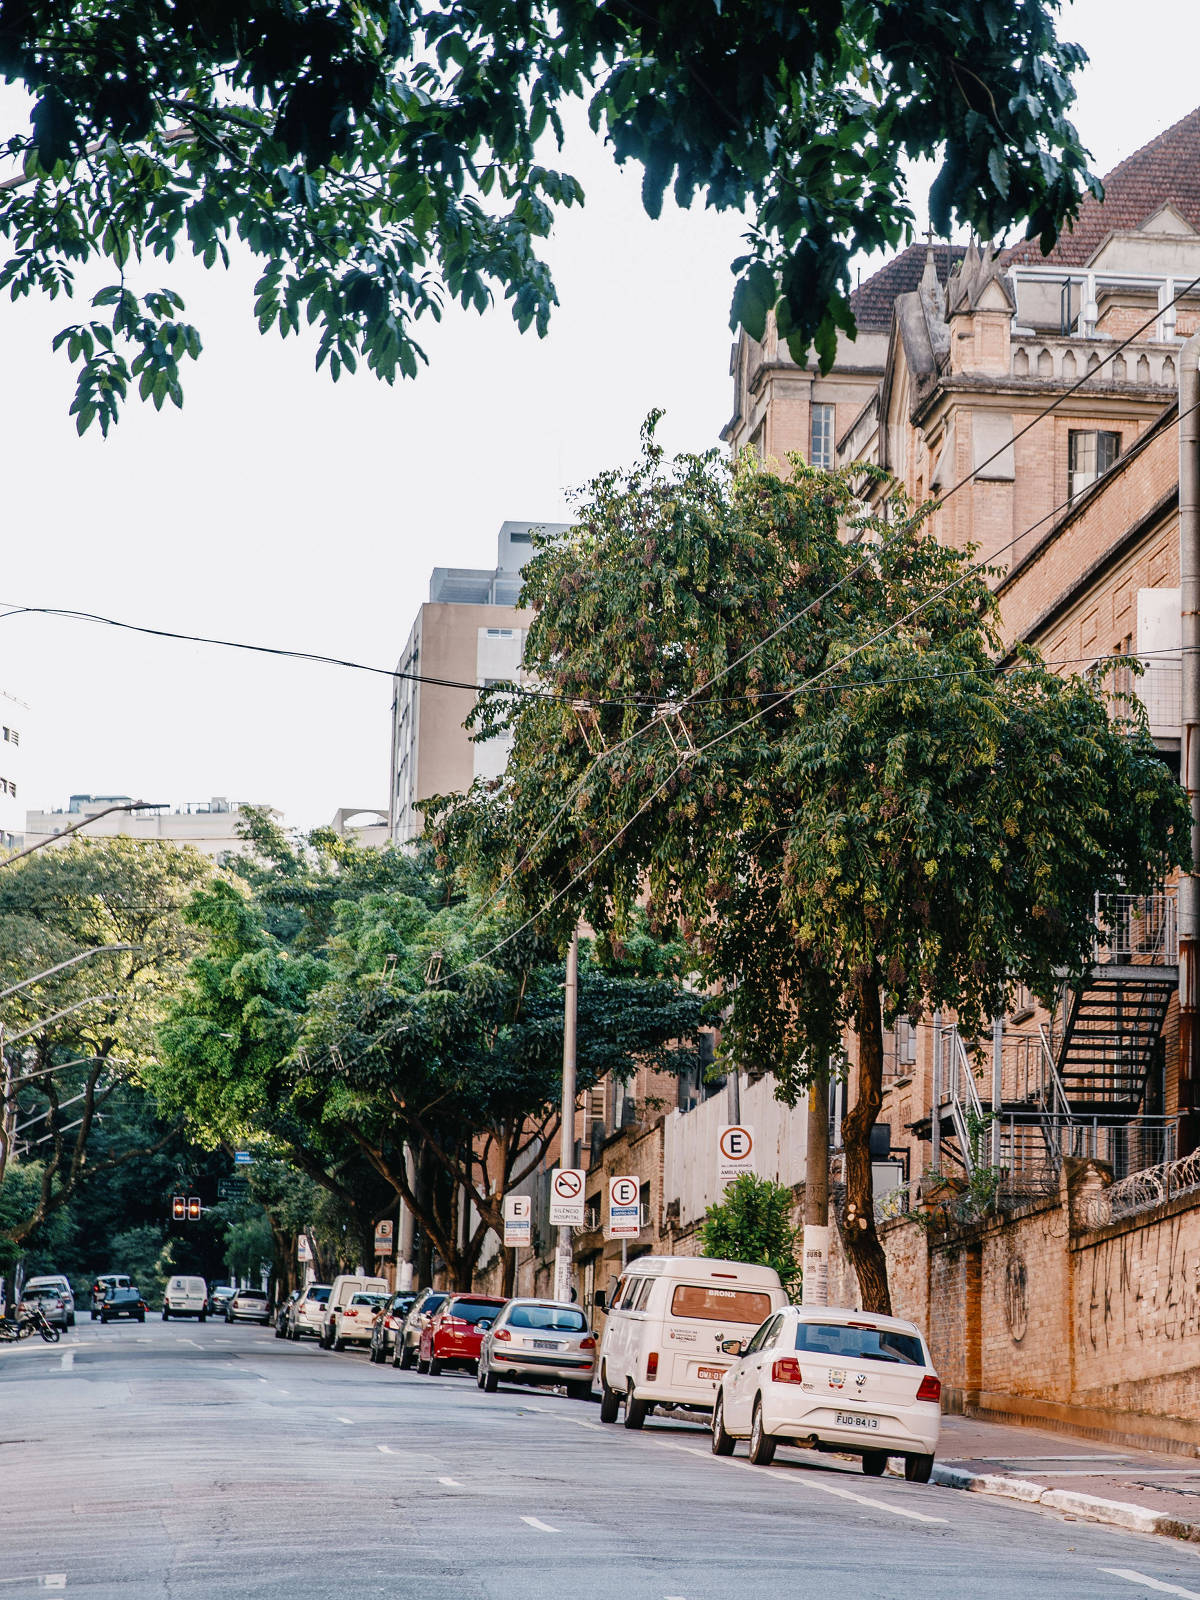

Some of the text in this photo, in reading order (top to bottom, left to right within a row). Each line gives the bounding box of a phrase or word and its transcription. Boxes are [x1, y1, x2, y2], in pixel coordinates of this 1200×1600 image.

[730, 1134, 742, 1153] E
[620, 1184, 630, 1200] E
[514, 1202, 522, 1215] E
[381, 1225, 387, 1234] E
[709, 1290, 736, 1298] BRONX
